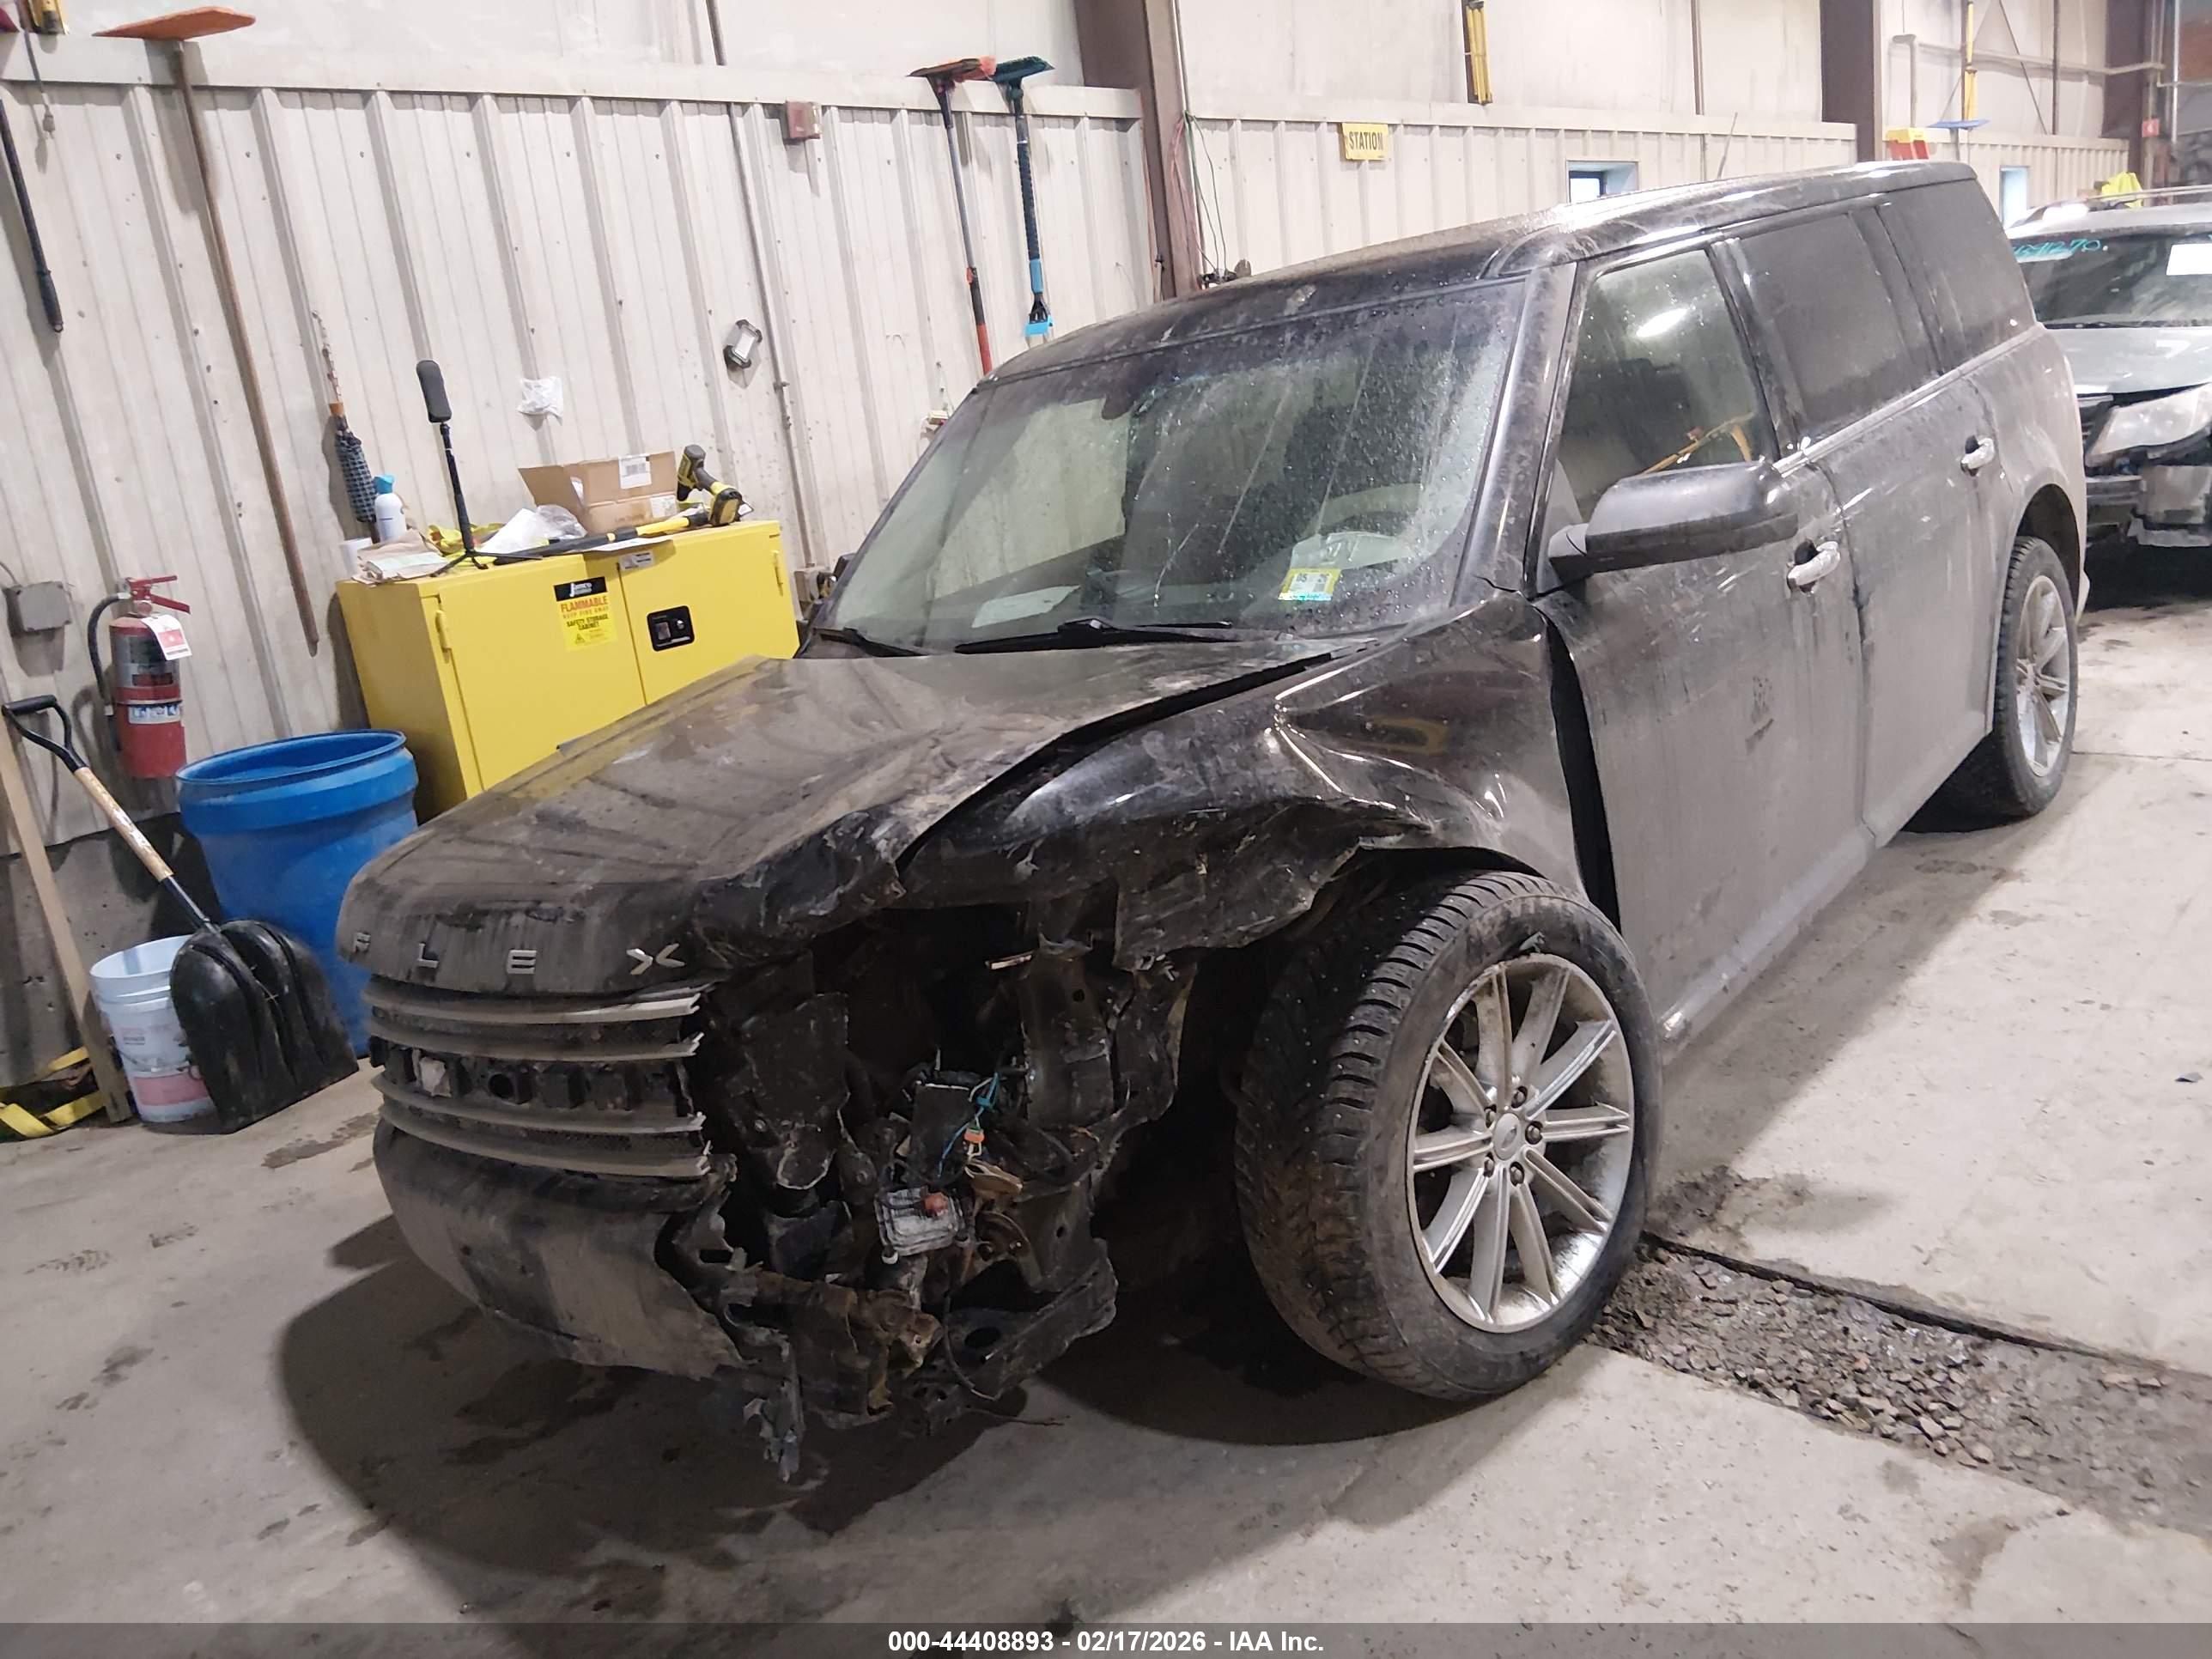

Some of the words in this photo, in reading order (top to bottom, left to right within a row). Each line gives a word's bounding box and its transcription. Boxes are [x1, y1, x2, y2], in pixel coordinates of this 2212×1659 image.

[1349, 131, 1383, 150] STATION
[561, 595, 608, 612] FLAMMABLE
[567, 618, 585, 628] SAFETY
[586, 613, 609, 623] STORAGE
[578, 621, 599, 631] CABINET
